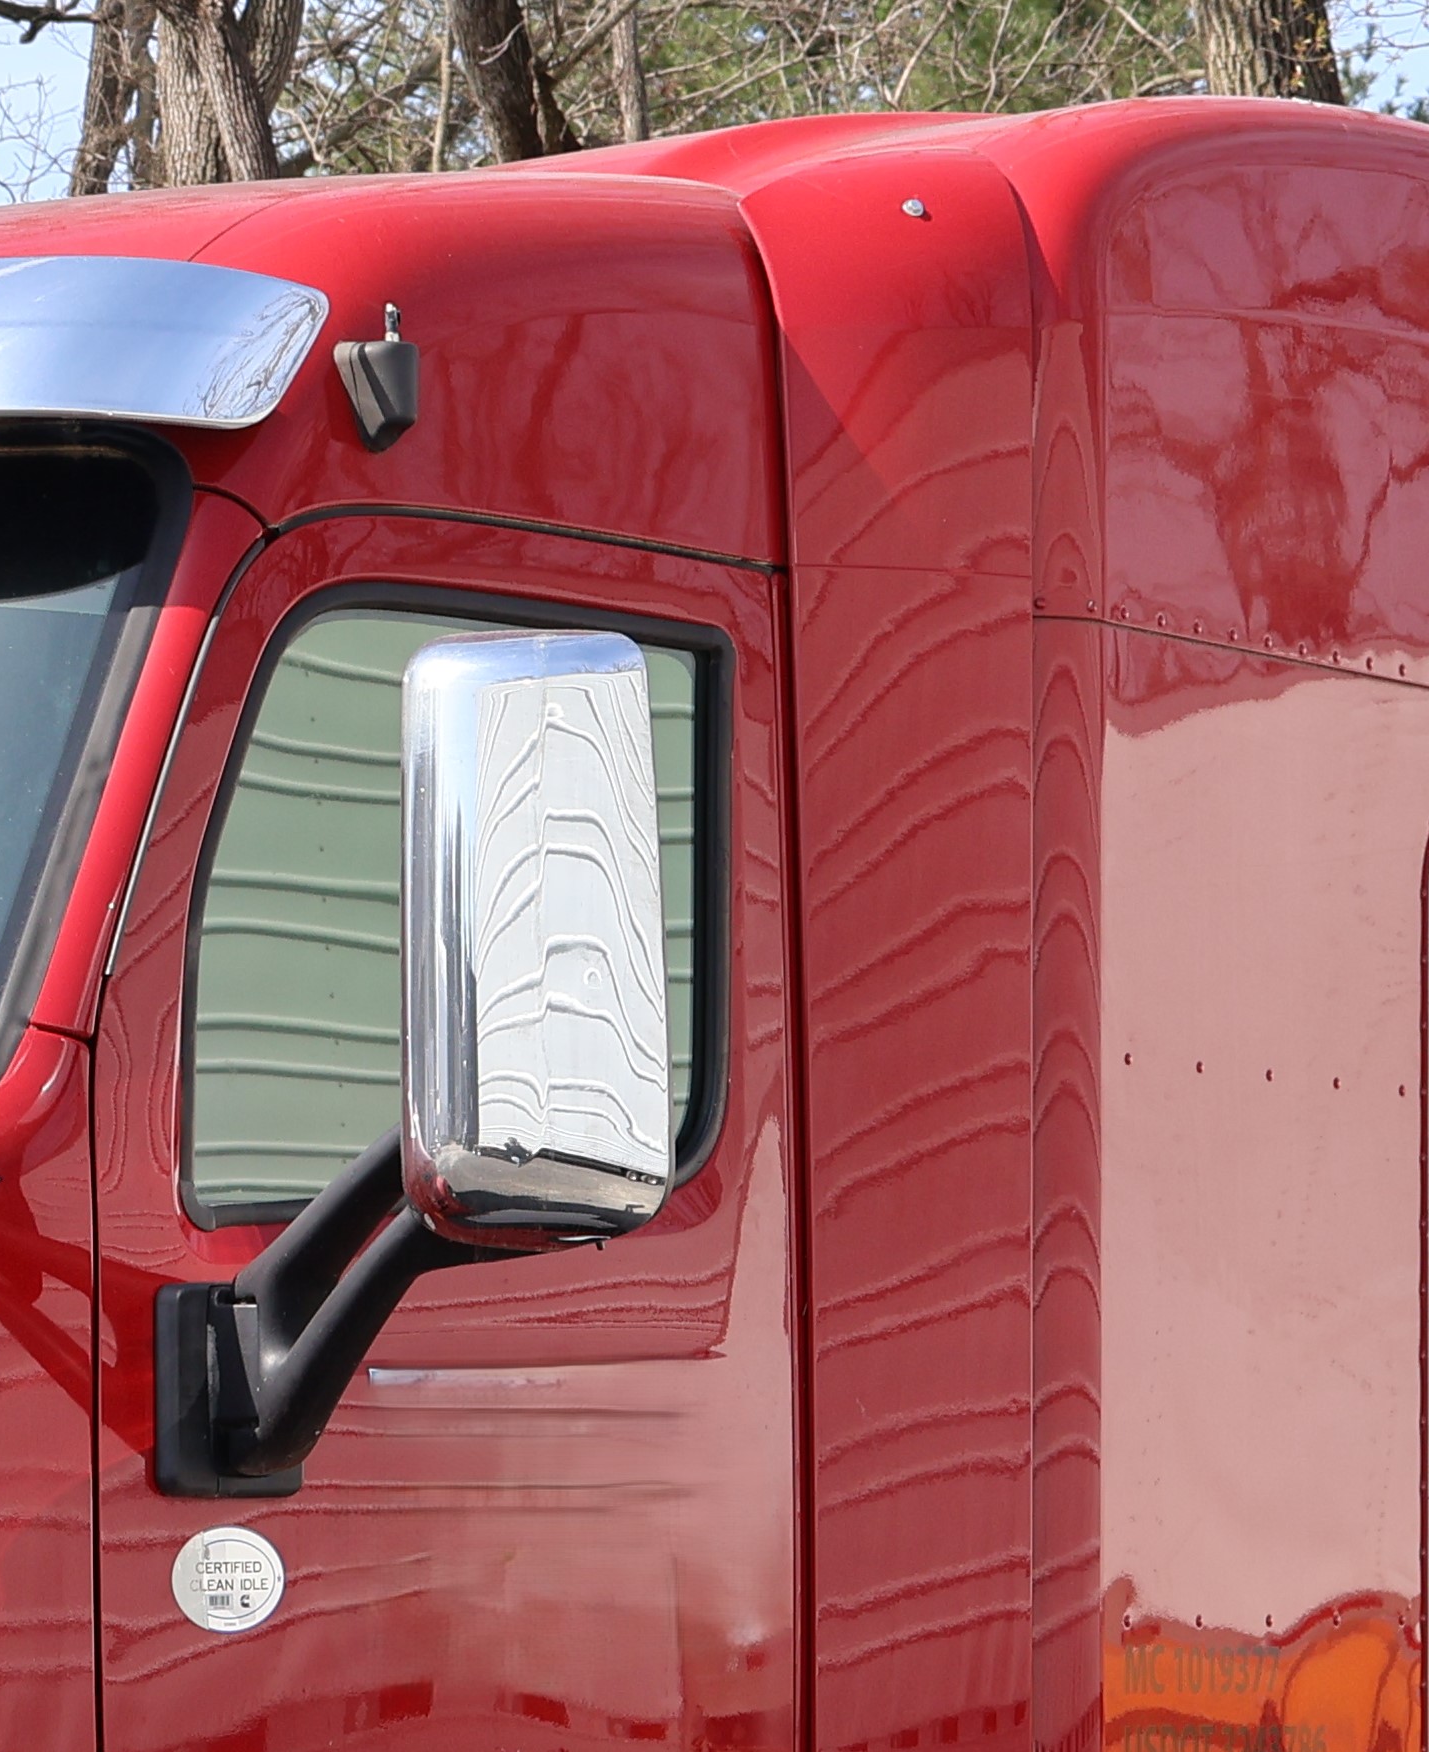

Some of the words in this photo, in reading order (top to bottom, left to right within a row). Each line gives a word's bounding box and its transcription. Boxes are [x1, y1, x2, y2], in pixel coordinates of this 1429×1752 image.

[195, 1561, 262, 1575] CERTIFIED
[240, 1578, 269, 1591] IDLE
[1124, 1644, 1164, 1695] MC
[1173, 1645, 1281, 1695] 1019377
